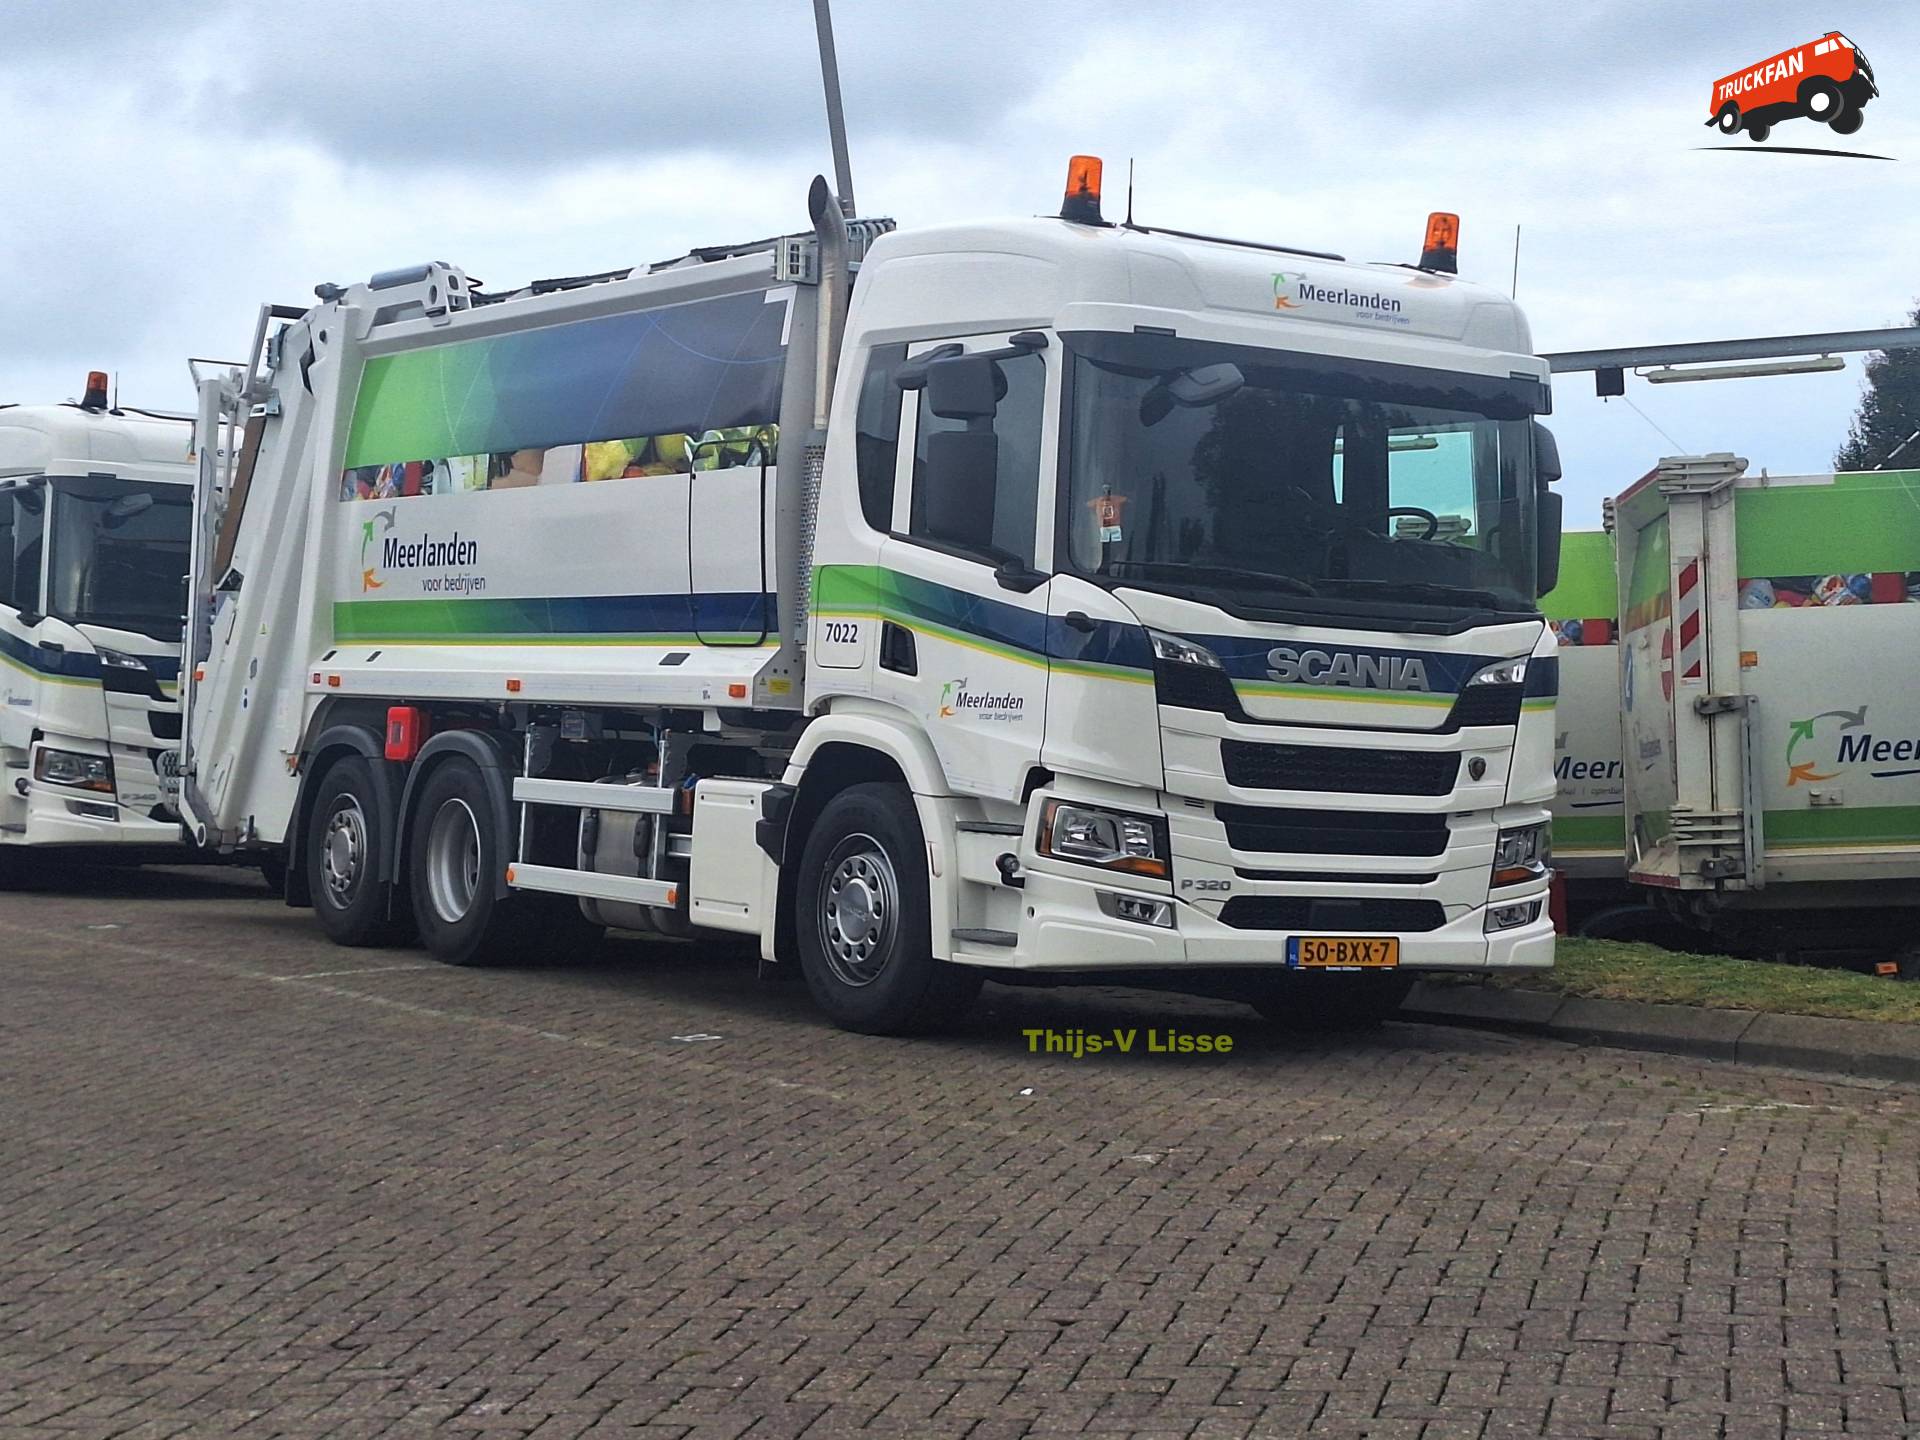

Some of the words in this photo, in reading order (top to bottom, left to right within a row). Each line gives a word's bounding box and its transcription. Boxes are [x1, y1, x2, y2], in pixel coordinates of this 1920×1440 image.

[1299, 283, 1401, 312] Meerlanden
[382, 531, 478, 569] Meerlanden
[422, 579, 442, 592] voor
[444, 573, 486, 595] bedrijven
[825, 622, 858, 644] 7022
[1266, 647, 1432, 692] SCANIA
[956, 691, 1024, 710] Meerlanden
[1181, 879, 1193, 890] P
[1195, 879, 1232, 891] 320
[1303, 941, 1390, 962] 50-BXX-7
